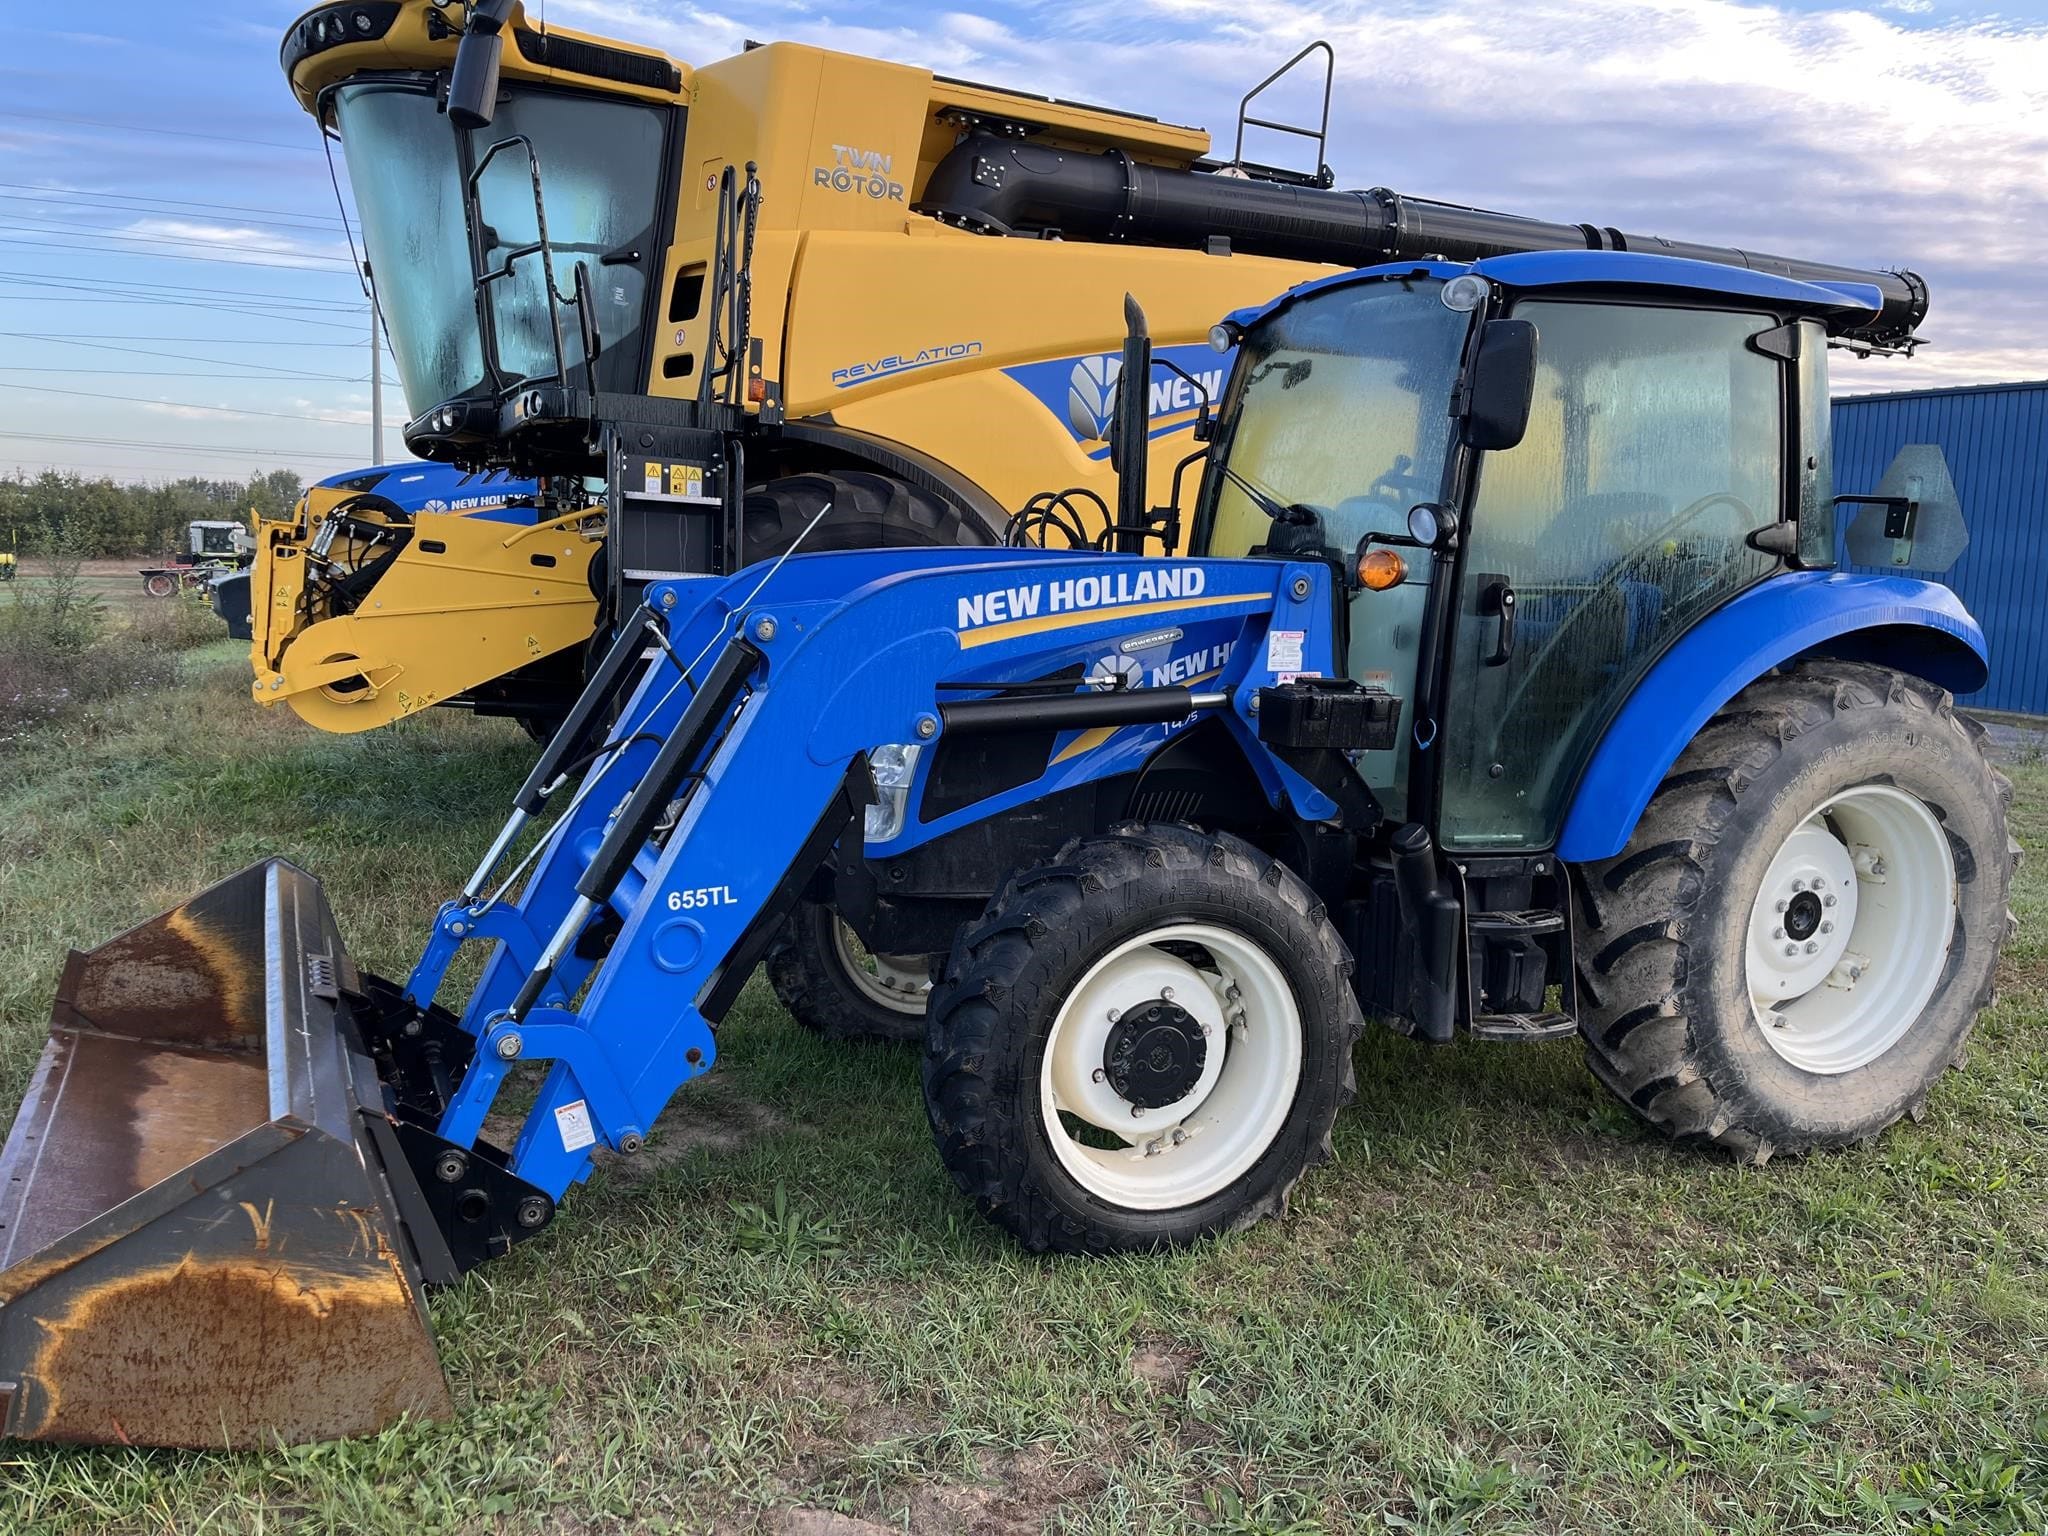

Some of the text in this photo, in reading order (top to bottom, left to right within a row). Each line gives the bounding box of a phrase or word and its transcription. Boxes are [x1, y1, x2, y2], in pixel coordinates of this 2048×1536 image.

[831, 144, 892, 175] TWIN
[814, 167, 904, 202] ROTOR
[831, 341, 983, 382] REVELATION
[1149, 369, 1223, 416] NEW
[451, 497, 479, 511] NEW
[957, 567, 1205, 629] NEW HOLLAND
[1152, 649, 1208, 688] NEW
[667, 885, 738, 911] 655TL
